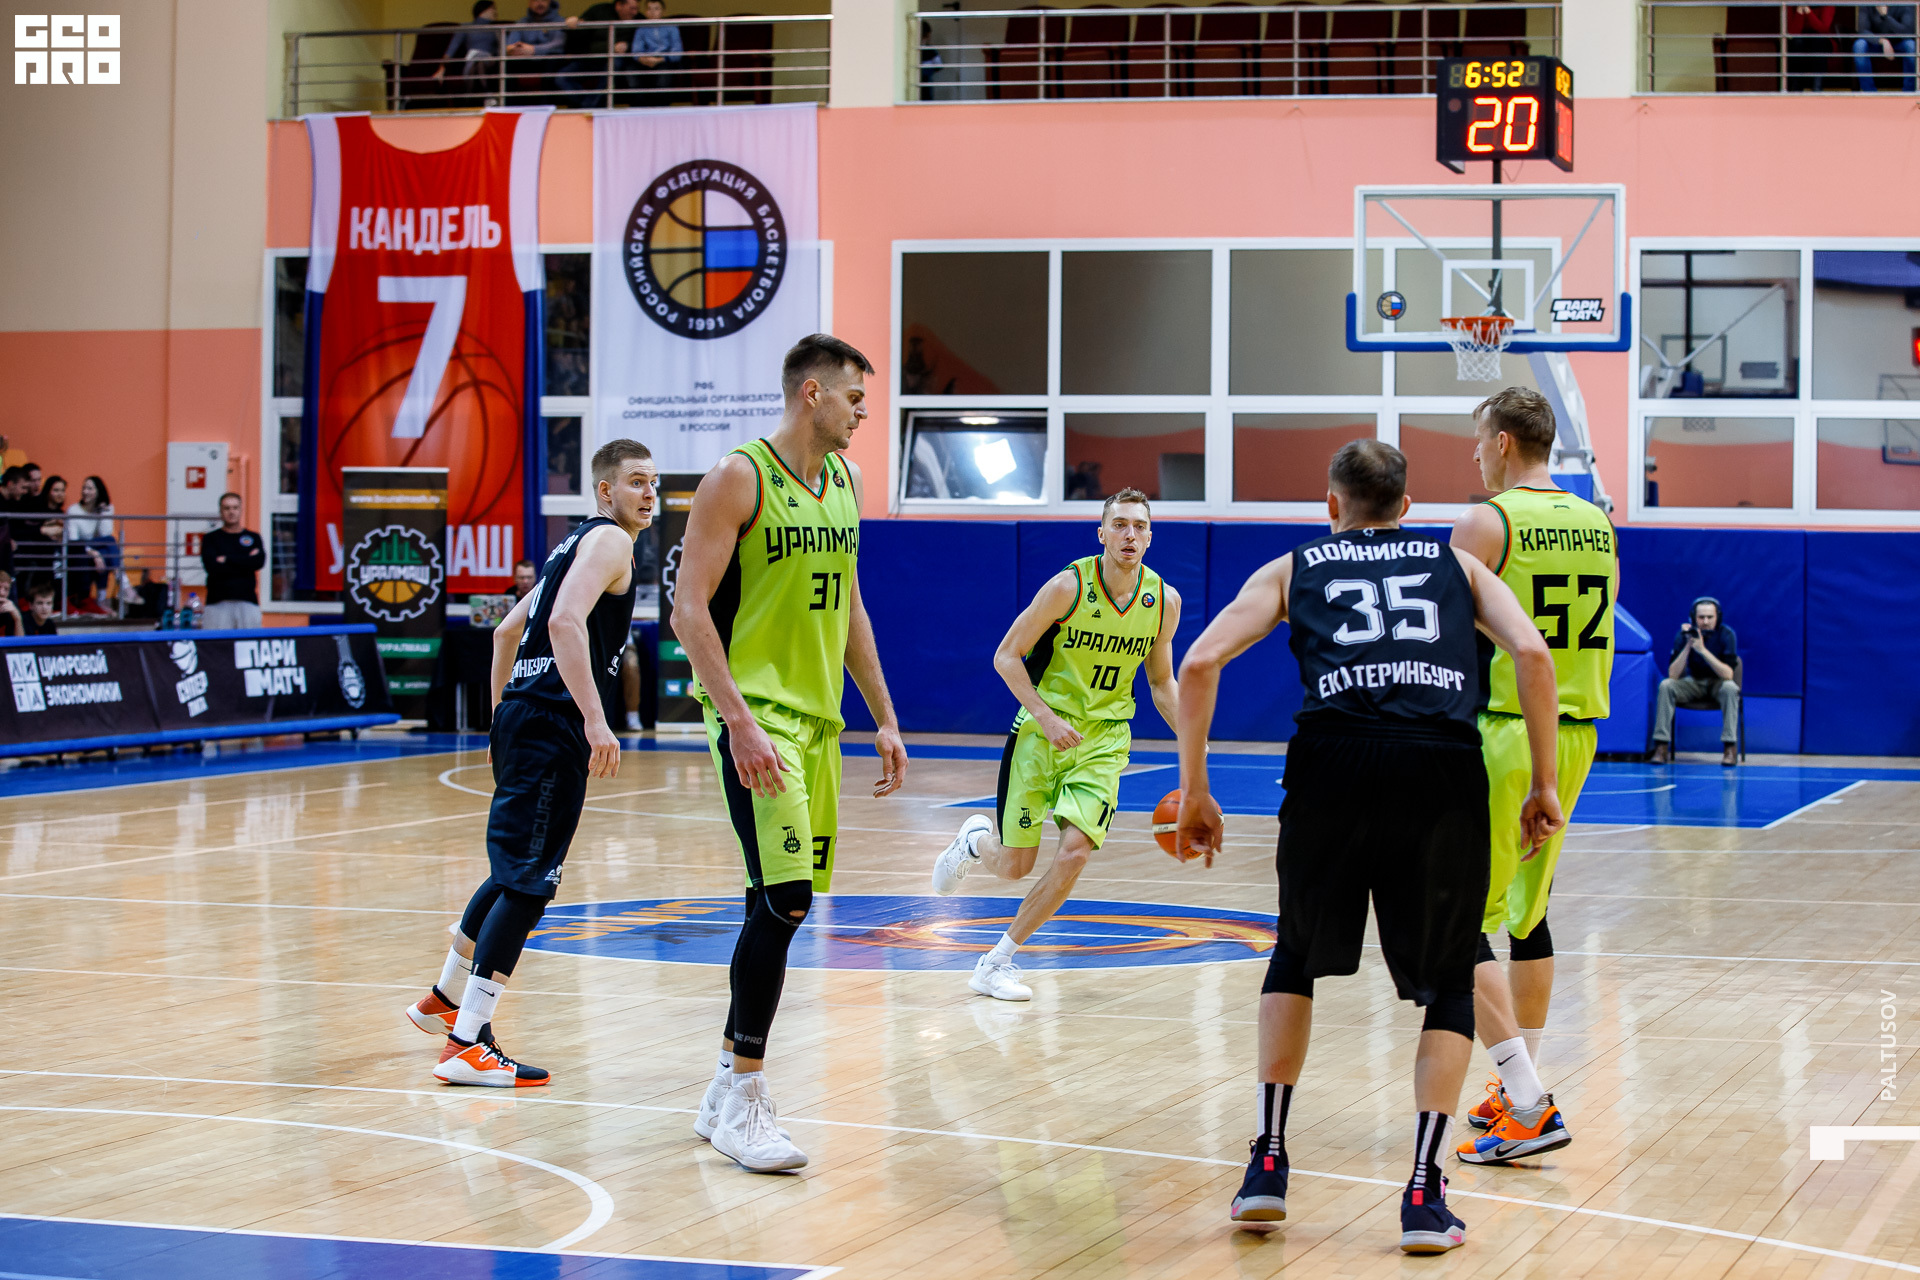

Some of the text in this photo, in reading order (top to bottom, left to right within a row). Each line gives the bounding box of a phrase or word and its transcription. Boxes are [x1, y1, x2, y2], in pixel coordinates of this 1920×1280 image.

[1465, 61, 1525, 88] 6:52
[1467, 97, 1538, 152] 20
[350, 205, 502, 255] КАНДЕЛЬ
[629, 167, 780, 324] РОССИЙСКАЯ ФЕДЕРАЦИЯ БАСКЕТБОЛА
[1552, 300, 1600, 311] ПАРИ
[1555, 310, 1603, 321] МАТЧ
[687, 316, 726, 331] 1991
[378, 275, 468, 439] 7
[723, 407, 784, 417] БАСКЕТБОЛ
[688, 422, 731, 432] РОССИИ
[1303, 539, 1440, 568] ДОЙНИКОВ
[1519, 528, 1610, 553] КАРПАЧЕВ
[360, 564, 431, 586] УРАЛМАШ
[809, 572, 842, 612] 31
[1325, 573, 1441, 646] 35
[1532, 574, 1610, 652] 52
[38, 649, 108, 681] ЦИФРОВОЙ
[234, 639, 297, 669] ПАРИ
[244, 667, 307, 697] МАТЧ
[508, 657, 556, 683] ИНБУРГ
[1090, 664, 1121, 692] 10
[1318, 660, 1465, 699] ЕКАТЕРИНБУРГ
[45, 681, 123, 706] ЭКОНОМИКИ
[812, 836, 838, 870] 3
[744, 1035, 763, 1045] PRO
